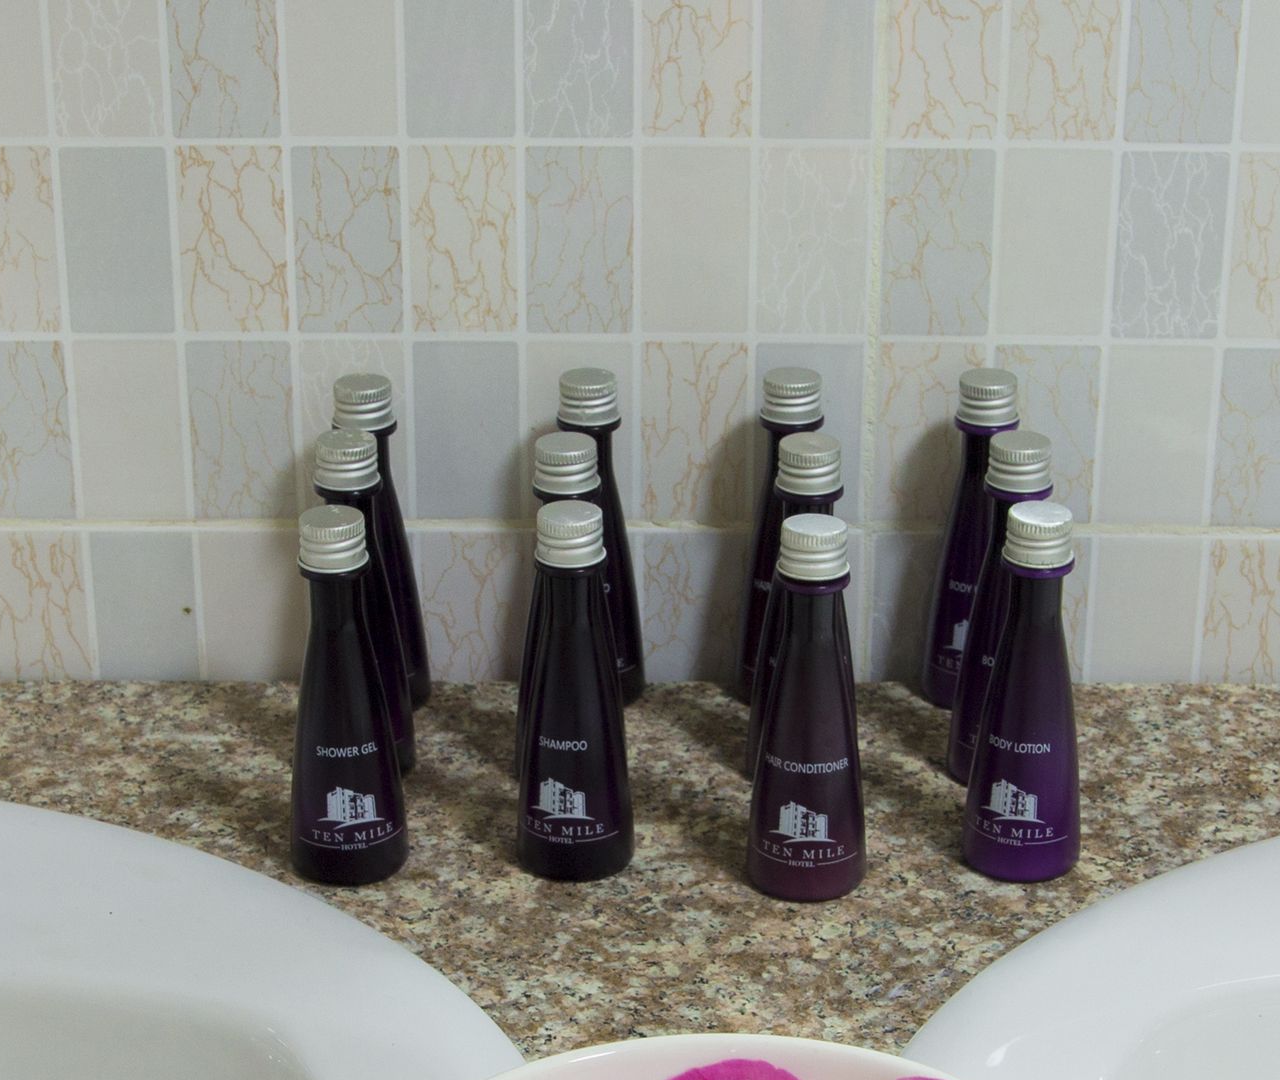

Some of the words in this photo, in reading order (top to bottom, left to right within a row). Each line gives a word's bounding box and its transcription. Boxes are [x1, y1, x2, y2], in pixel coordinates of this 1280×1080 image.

[316, 745, 360, 758] SHOWER
[361, 741, 379, 755] GEL
[538, 735, 588, 751] SHAMPOO
[989, 734, 1013, 751] BODY
[1014, 743, 1051, 754] LOTION
[783, 757, 849, 774] CONDITIONER
[312, 829, 345, 842] TEN
[354, 821, 394, 842] MILE
[526, 815, 553, 833] TEN
[561, 823, 605, 837] MILE
[976, 816, 1002, 834] TEN
[1011, 826, 1054, 839] MILE
[341, 842, 369, 851] HOTEL
[548, 835, 575, 845] HOTEL
[997, 836, 1023, 847] HOTEL
[762, 839, 793, 857] TEN
[802, 844, 845, 860] MILE
[788, 859, 816, 868] HOTEL
